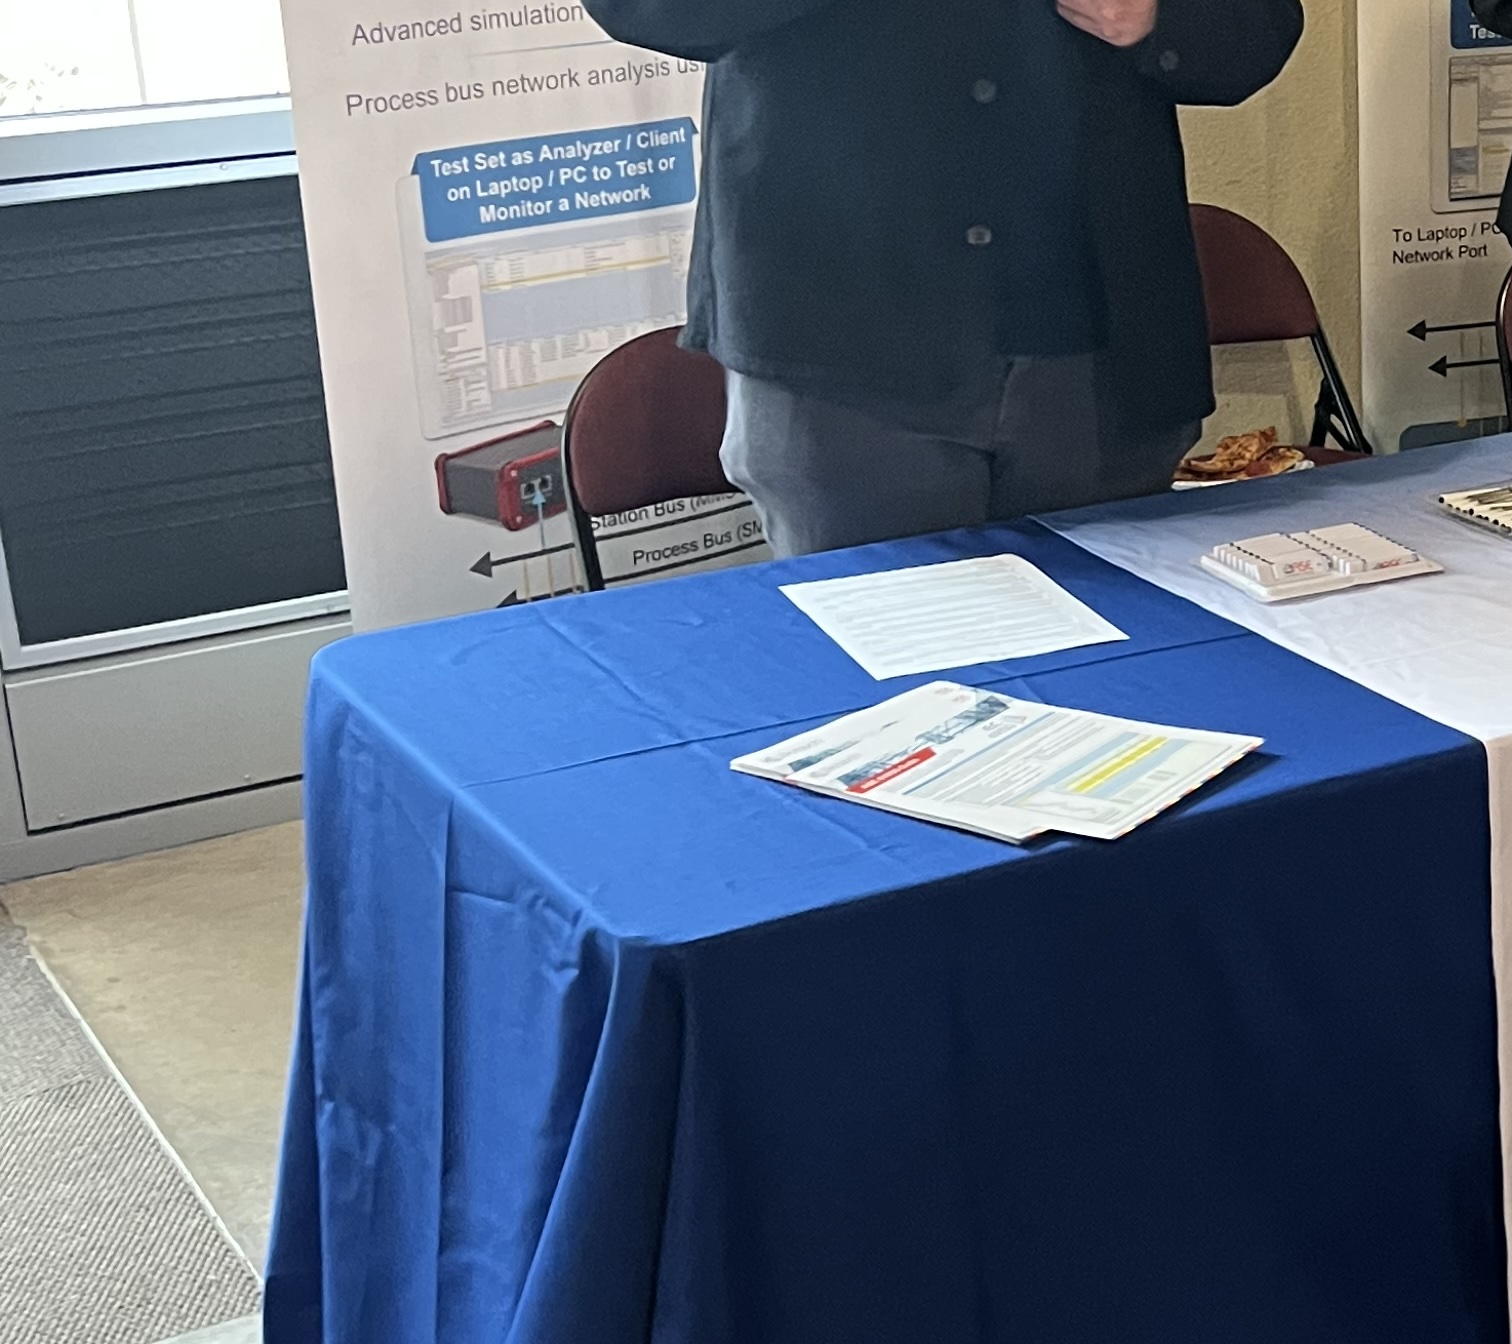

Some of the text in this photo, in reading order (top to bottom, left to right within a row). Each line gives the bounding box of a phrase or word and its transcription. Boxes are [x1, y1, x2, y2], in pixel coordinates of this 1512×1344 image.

[351, 3, 585, 46] Advanced simulation
[346, 89, 439, 117] Process
[445, 80, 485, 103] bus
[491, 69, 581, 98] network
[587, 58, 671, 91] analysis
[431, 126, 687, 178] Test Set as Analyzer / Client
[446, 156, 677, 202] on Laptop / PC to Test or
[479, 184, 652, 224] Monitor a Network
[1392, 228, 1413, 242] To
[1417, 225, 1468, 243] Laptop
[1470, 222, 1477, 237] /
[1392, 243, 1488, 265] Network Port
[653, 499, 686, 517] Bus
[632, 538, 699, 566] Process
[703, 529, 732, 549] Bus
